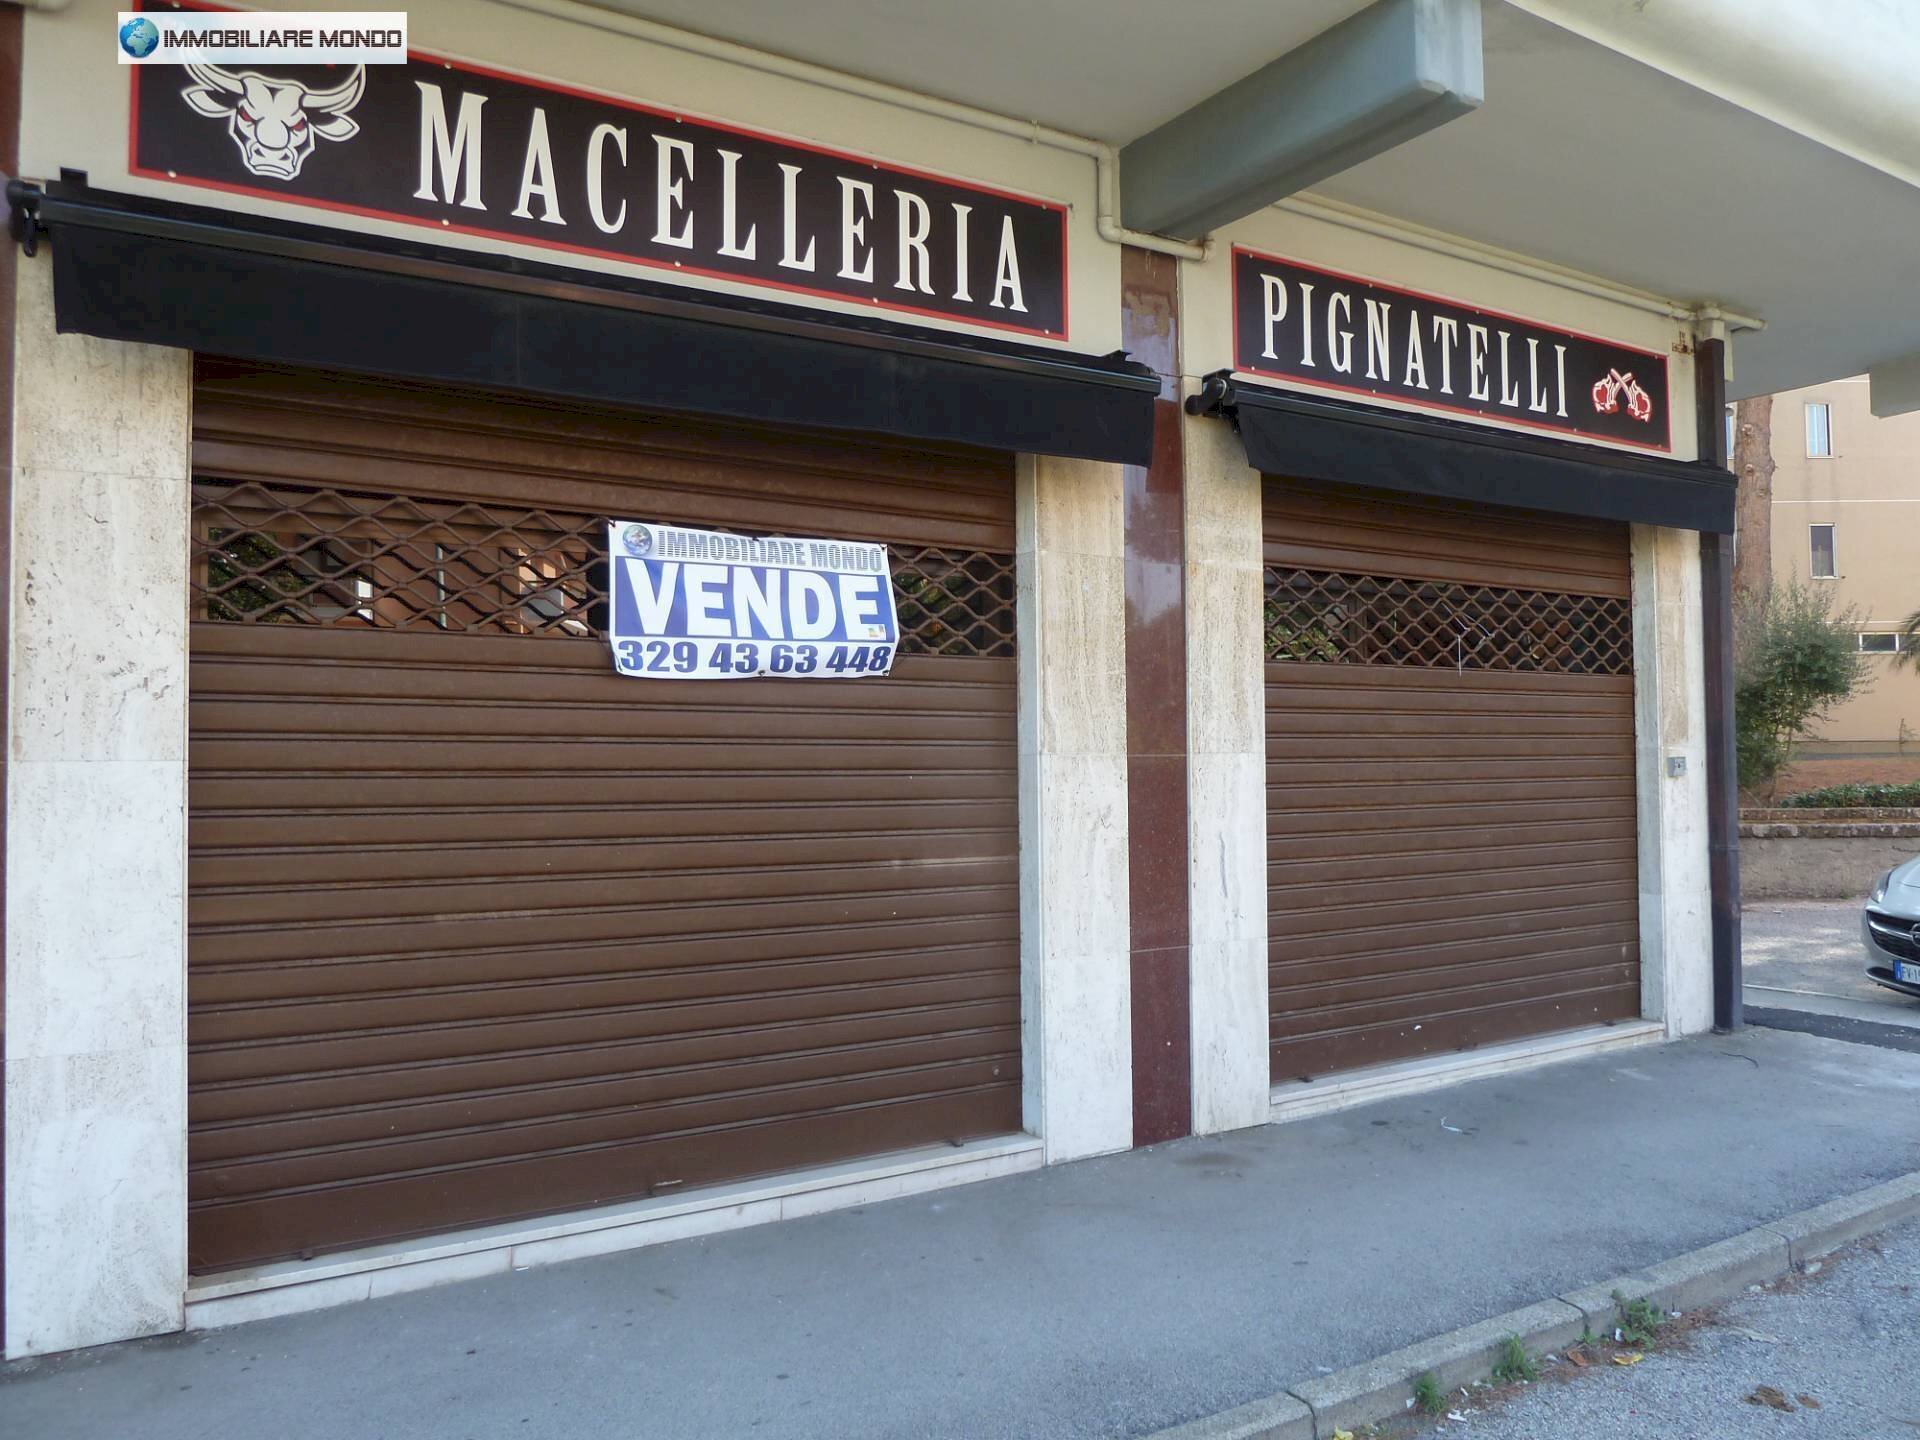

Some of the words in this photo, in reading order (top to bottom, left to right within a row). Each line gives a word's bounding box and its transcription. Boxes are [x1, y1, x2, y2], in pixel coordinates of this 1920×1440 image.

[412, 80, 1028, 313] MACELLERIA
[1259, 273, 1569, 418] PIGNATELLI
[658, 530, 806, 566] IMMOBILIARE
[810, 542, 882, 572] MONDO
[625, 558, 887, 641] VENDE
[618, 640, 698, 673] 329
[709, 643, 759, 674] 43
[770, 644, 818, 674] 63
[826, 645, 891, 673] 448
